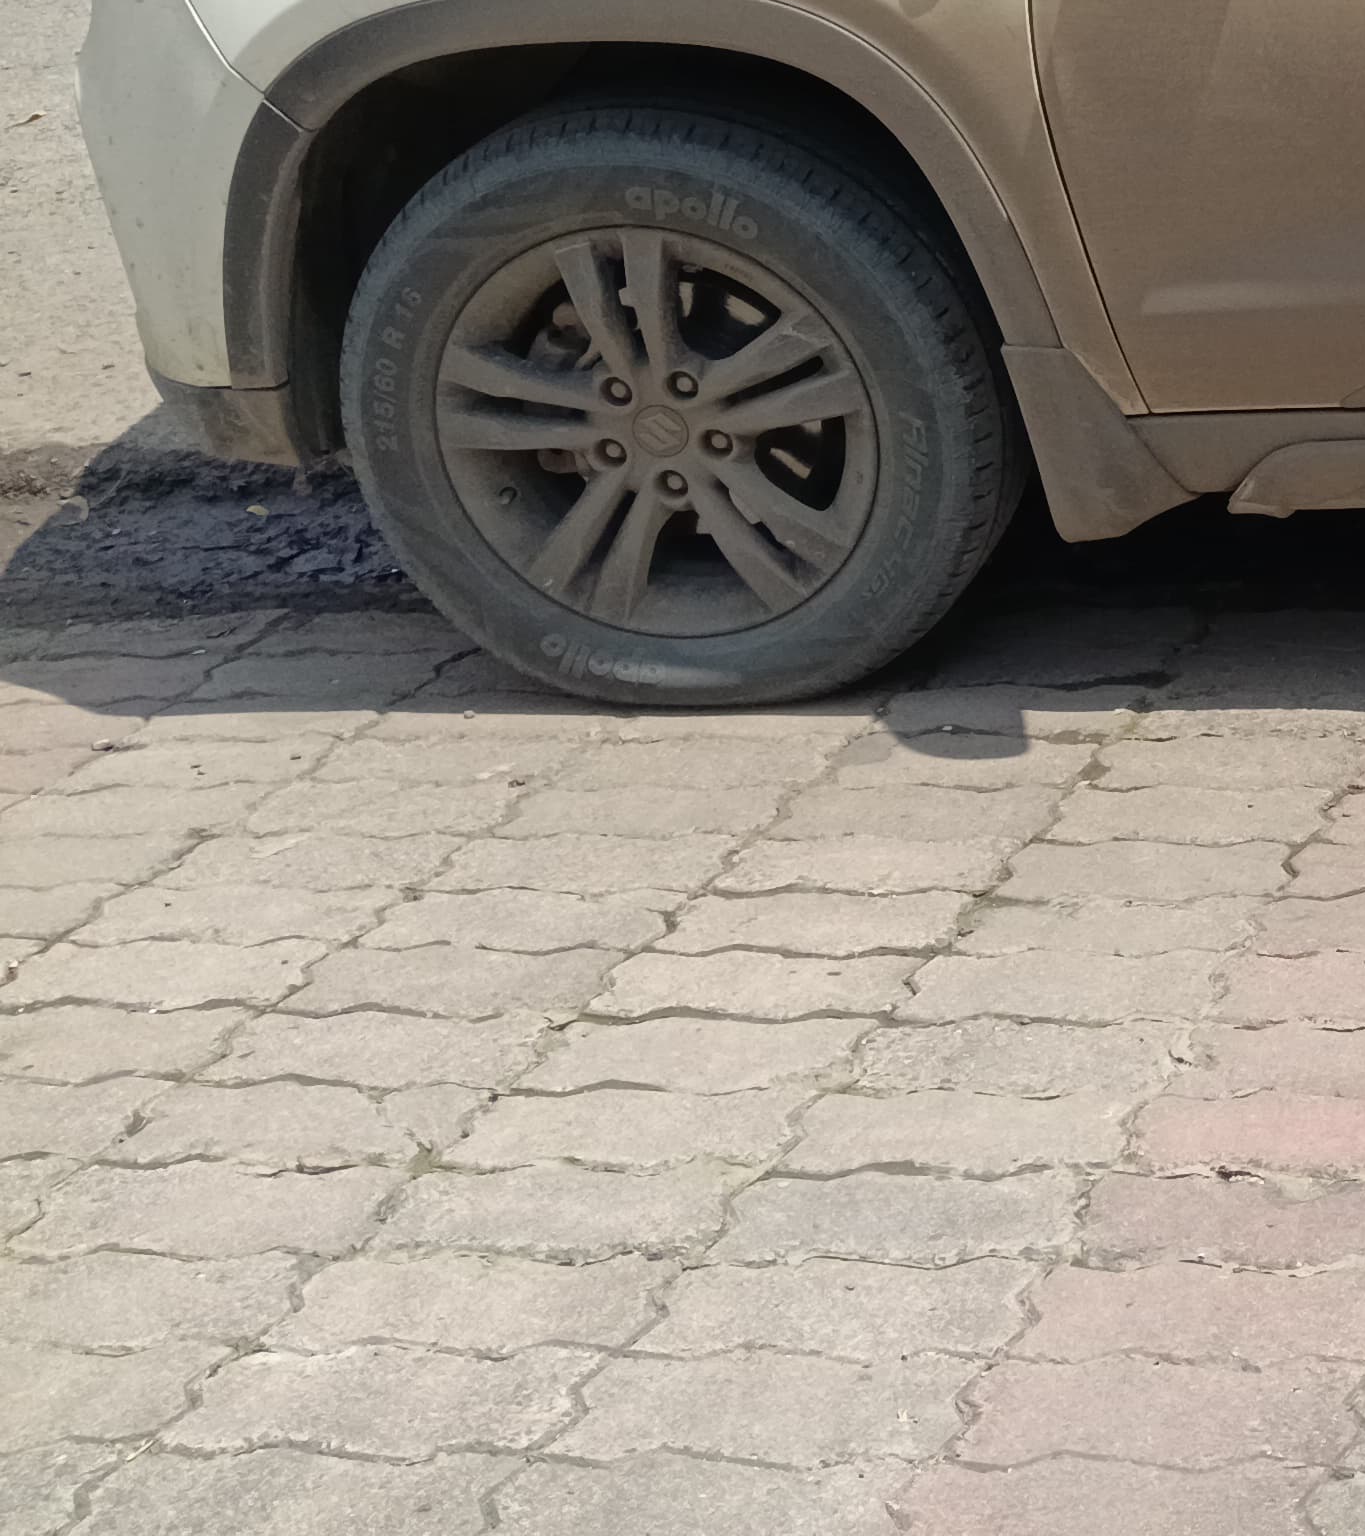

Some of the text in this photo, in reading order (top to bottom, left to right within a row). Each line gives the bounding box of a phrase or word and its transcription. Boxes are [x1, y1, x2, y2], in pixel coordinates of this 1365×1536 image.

[625, 186, 758, 240] apollo
[373, 358, 398, 452] 215/60
[540, 633, 664, 684] apollo
